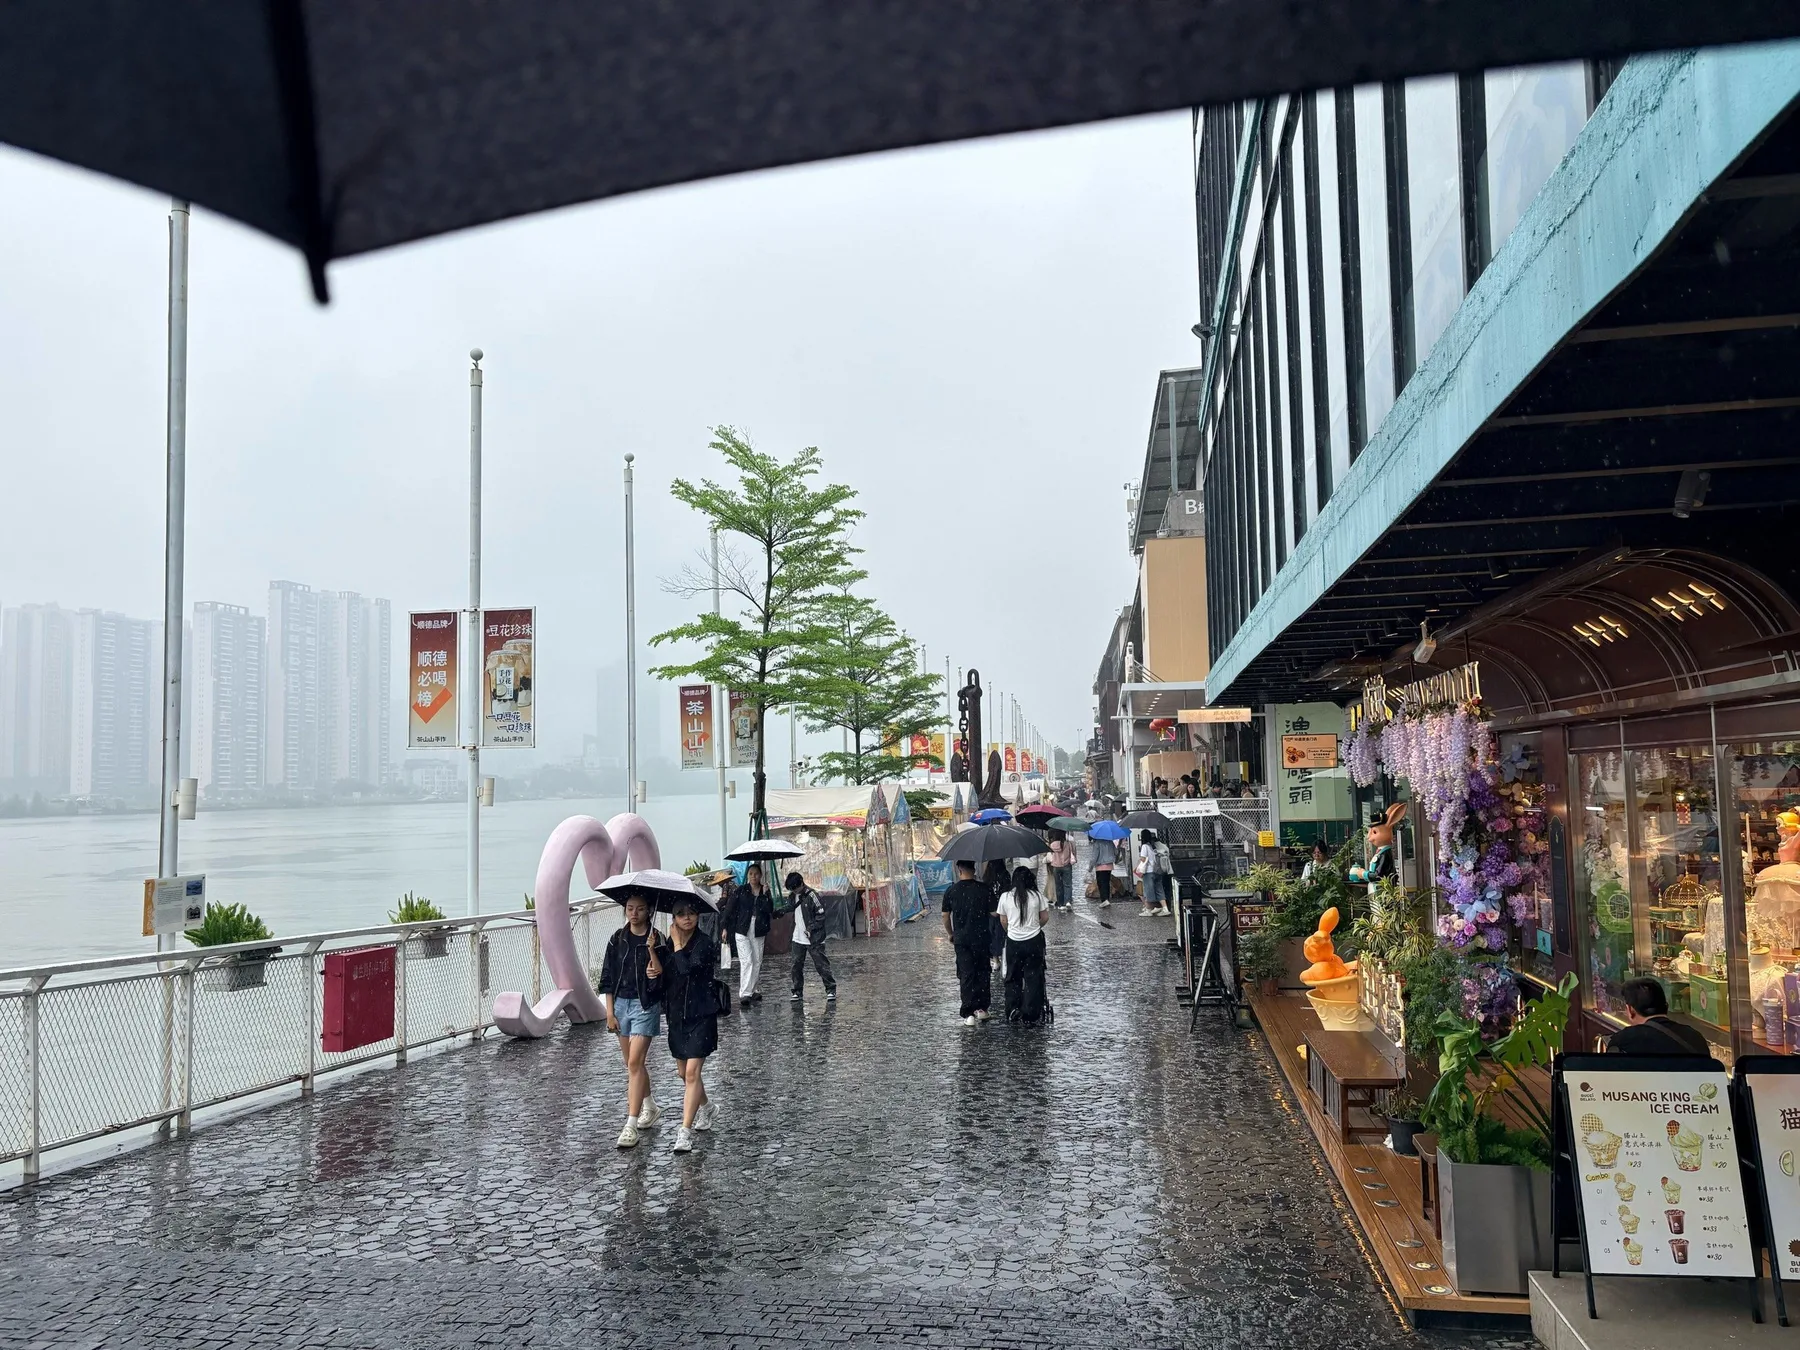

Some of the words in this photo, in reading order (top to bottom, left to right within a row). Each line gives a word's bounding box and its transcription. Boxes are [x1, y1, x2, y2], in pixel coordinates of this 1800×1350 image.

[488, 624, 532, 637] 豆花珍珠
[417, 650, 447, 667] 顺德
[417, 670, 447, 687] 必喝
[417, 690, 432, 708] 榜
[686, 700, 705, 749] 茶山山
[1602, 1091, 1658, 1102] MUSANG
[1660, 1092, 1691, 1102] KING
[1650, 1104, 1670, 1114] ICE
[1674, 1104, 1720, 1114] CREAM
[1585, 1172, 1609, 1182] Combo
